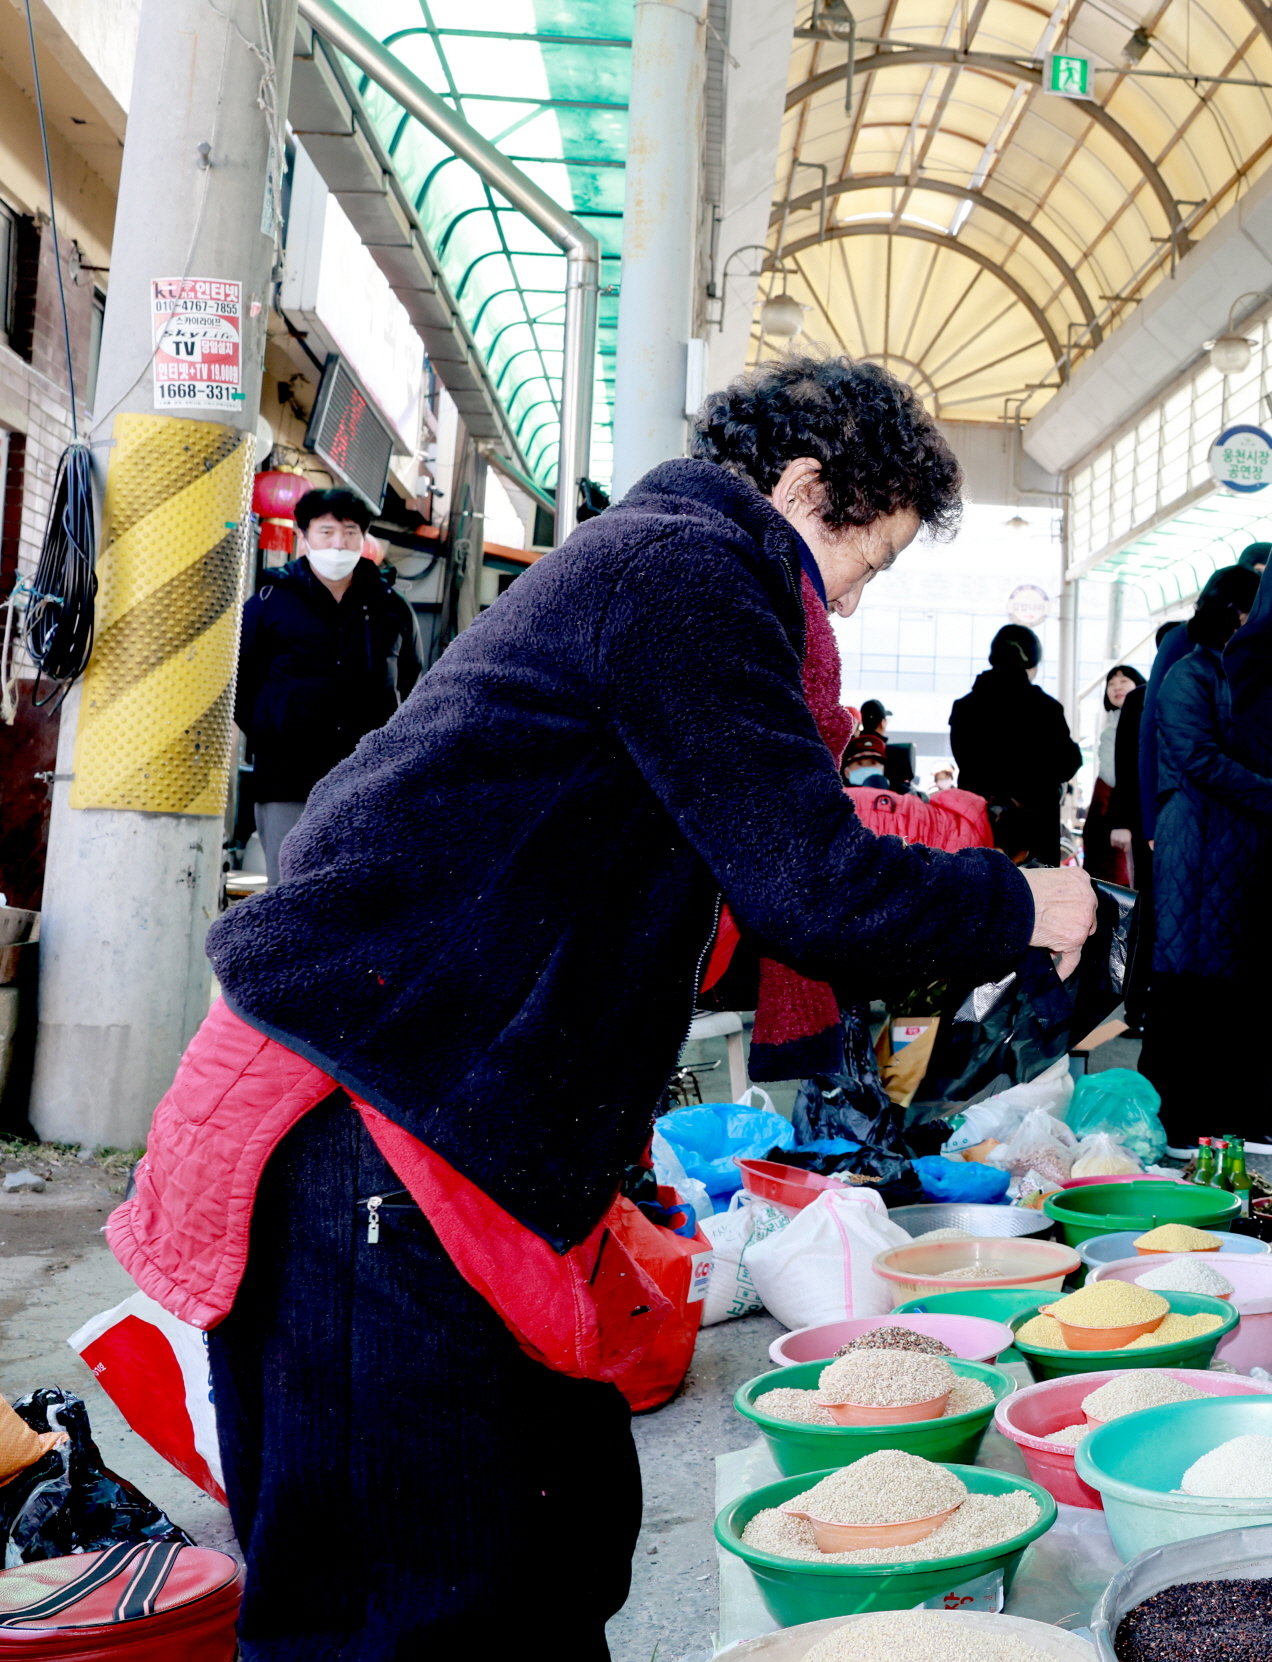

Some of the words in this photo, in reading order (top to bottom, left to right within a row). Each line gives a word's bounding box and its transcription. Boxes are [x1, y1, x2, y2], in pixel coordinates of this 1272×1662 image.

[155, 283, 177, 299] kt
[195, 281, 238, 302] 인터넷
[156, 300, 238, 315] 010-4767-7855
[176, 316, 222, 327] 스카이라이프
[173, 341, 196, 356] TV
[201, 340, 234, 356] 당일설치
[157, 362, 208, 380] 인터넷+TV
[1222, 448, 1270, 465] 웅천시장
[1227, 464, 1264, 481] 공연장
